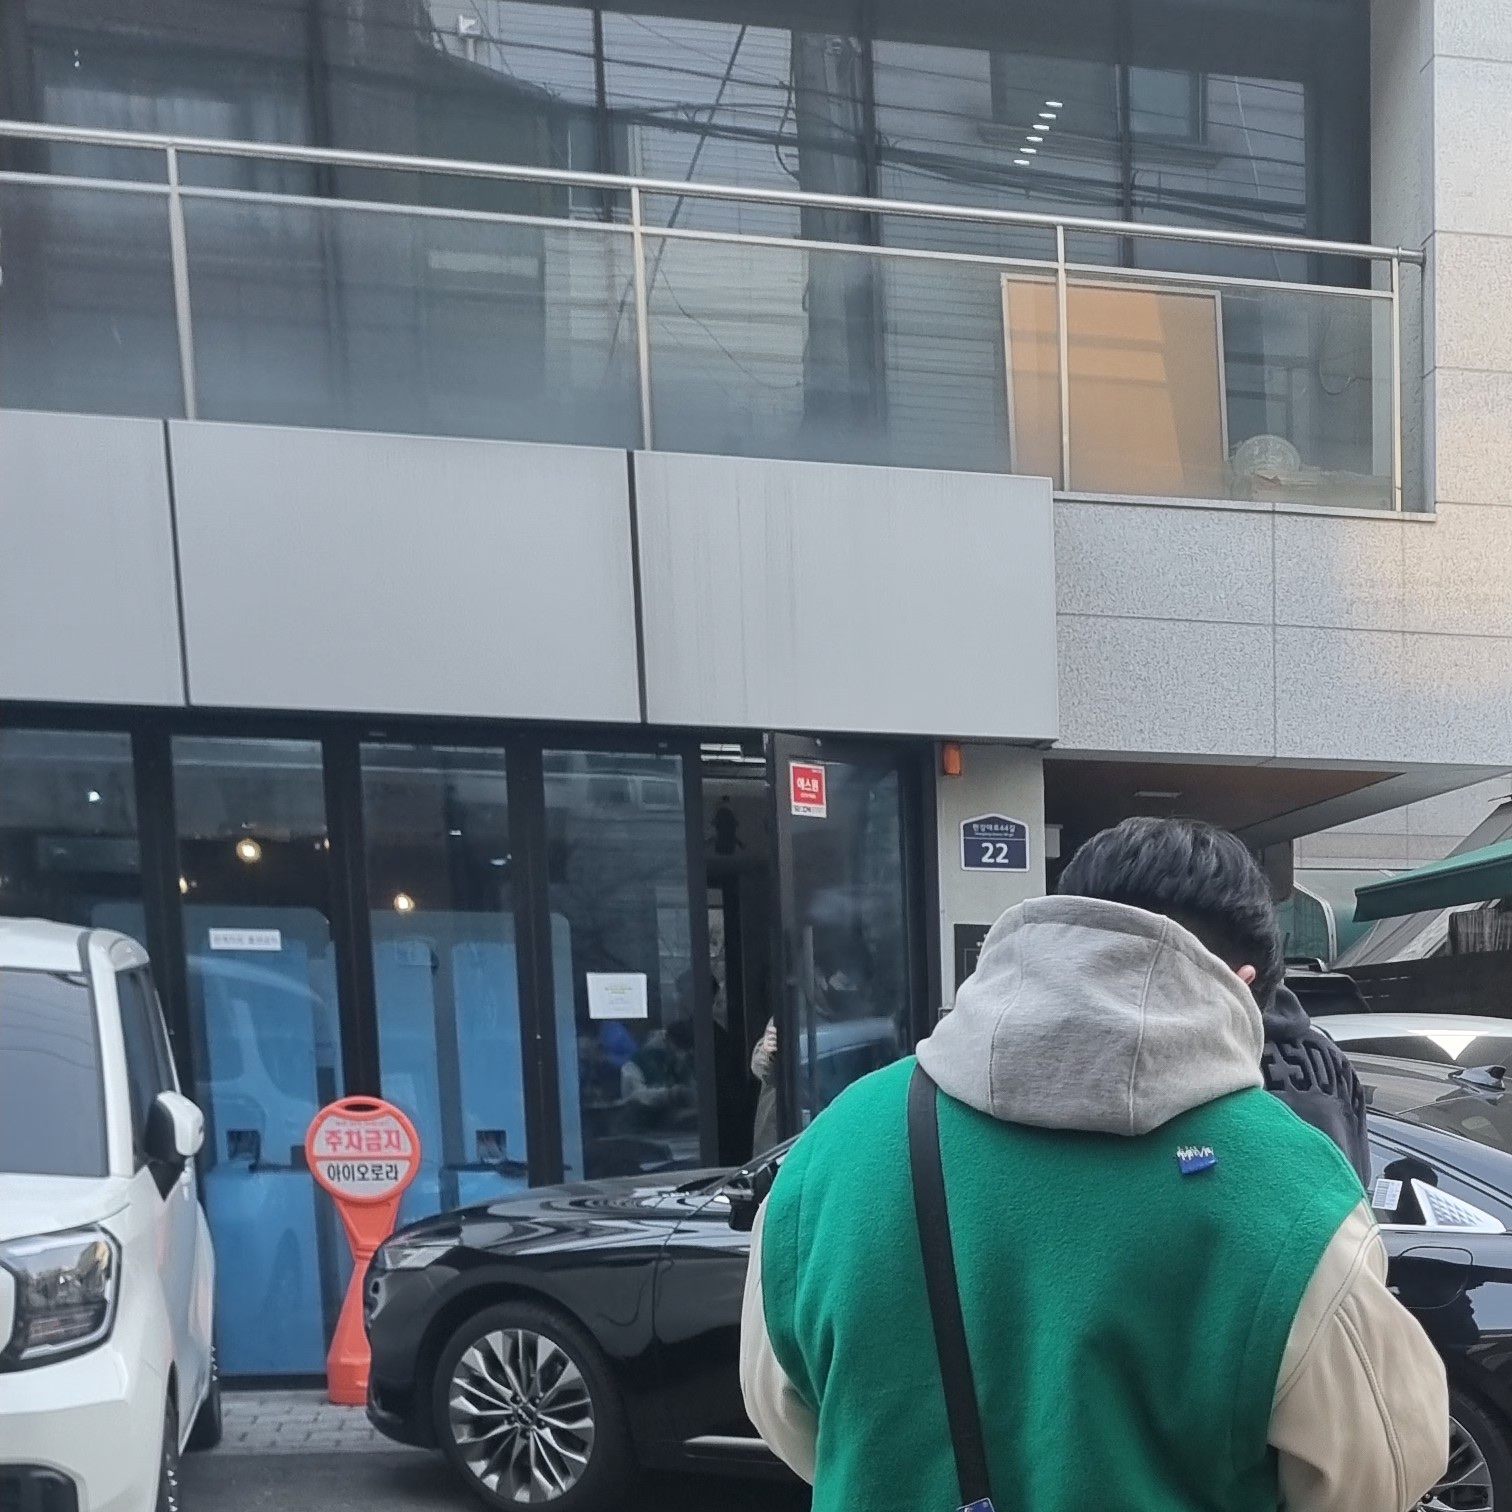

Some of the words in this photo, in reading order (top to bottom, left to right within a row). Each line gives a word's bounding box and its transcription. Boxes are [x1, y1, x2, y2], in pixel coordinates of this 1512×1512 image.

[980, 842, 1009, 864] 22
[324, 1128, 402, 1153] 주차금지
[326, 1163, 400, 1183] 아이오로라
